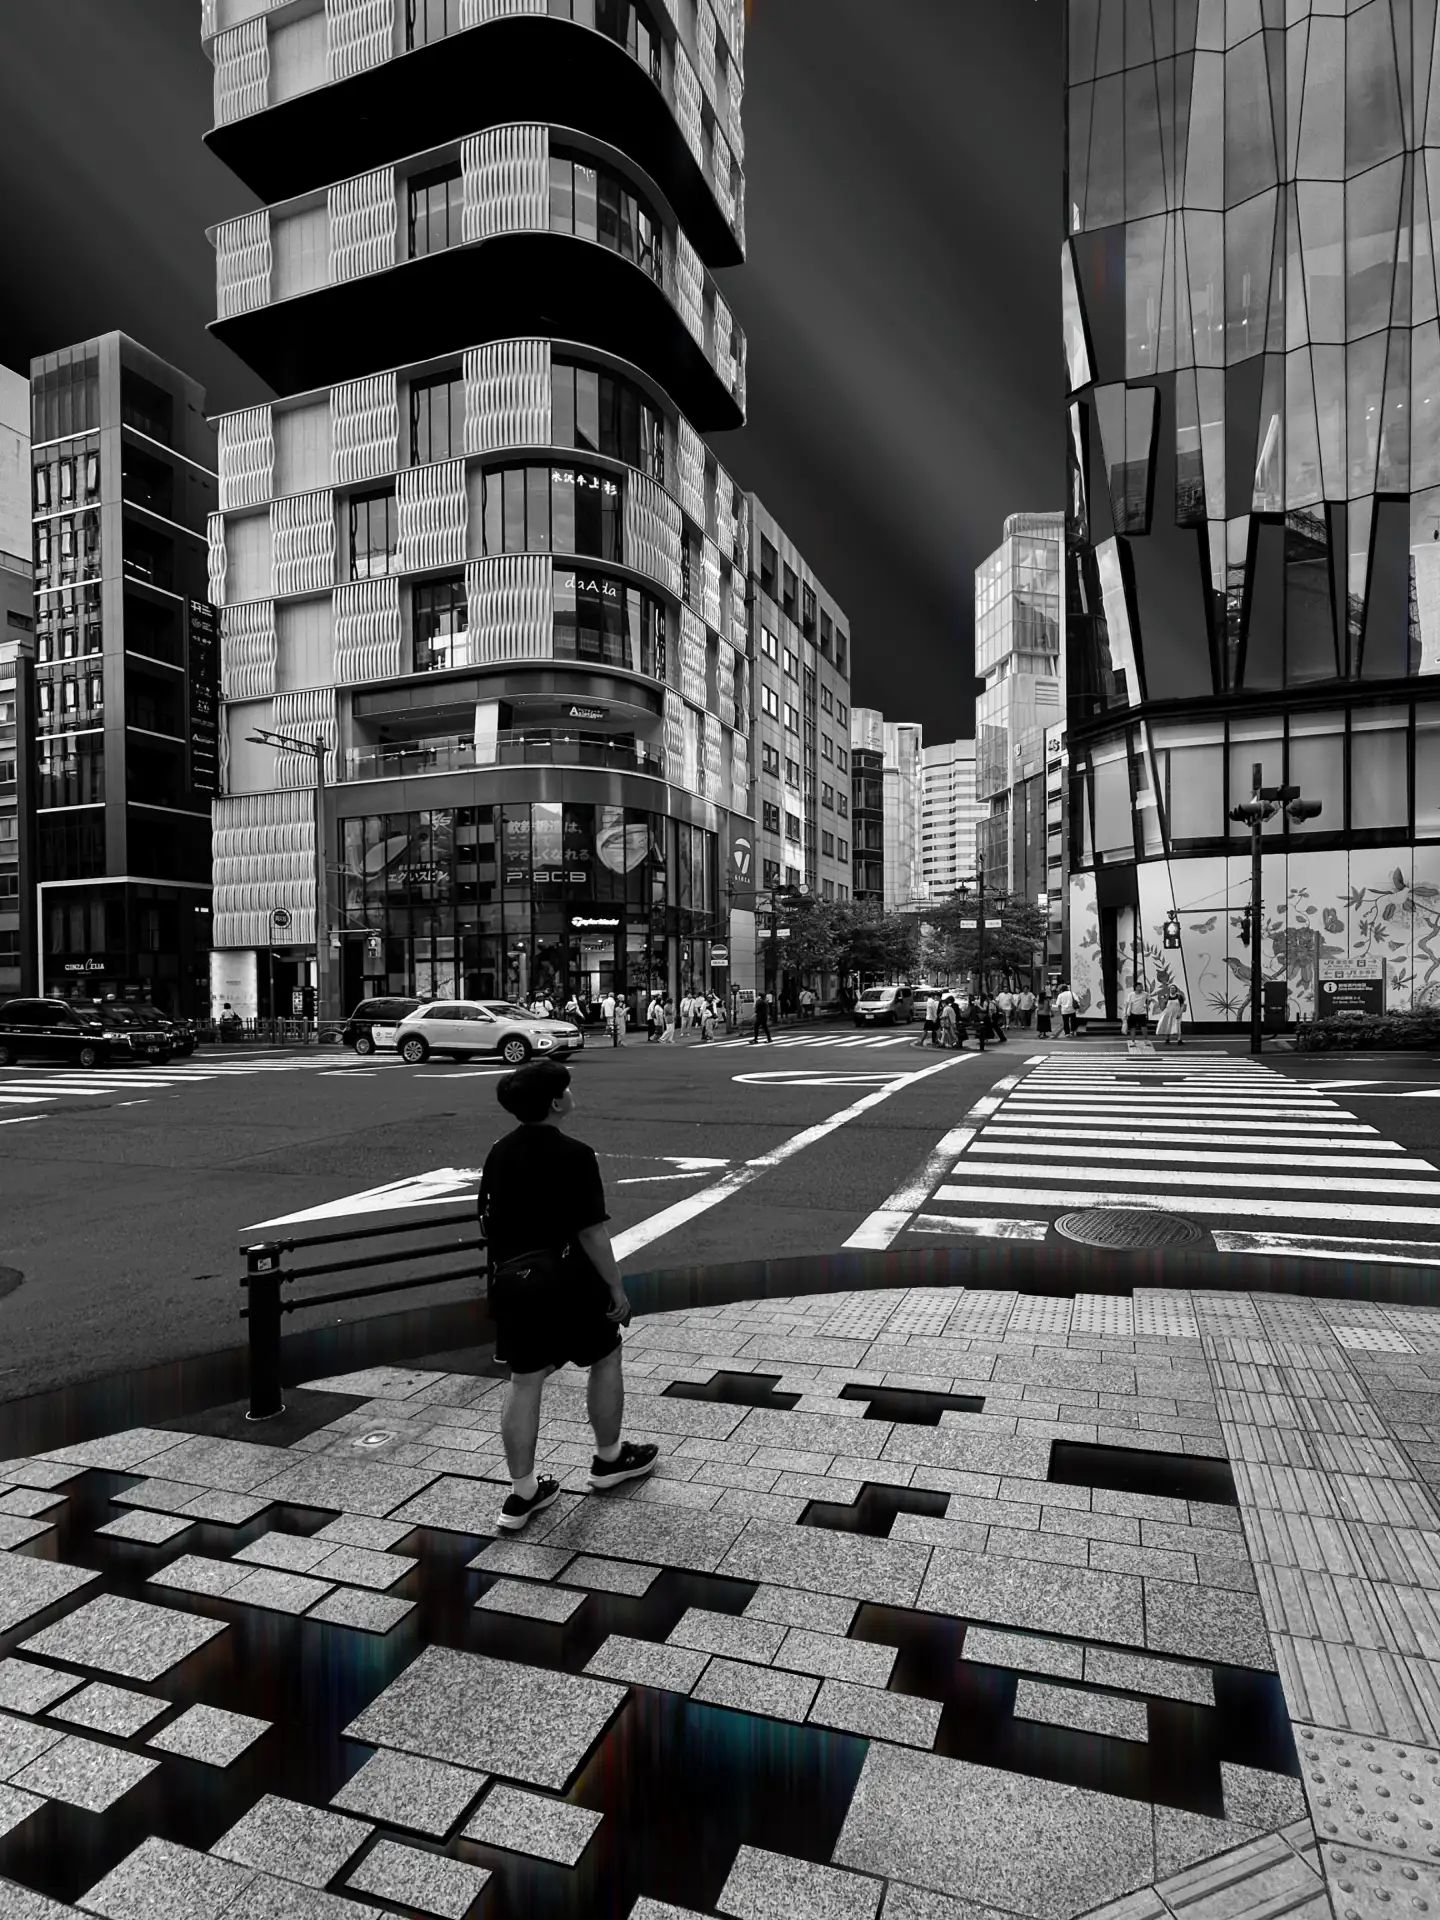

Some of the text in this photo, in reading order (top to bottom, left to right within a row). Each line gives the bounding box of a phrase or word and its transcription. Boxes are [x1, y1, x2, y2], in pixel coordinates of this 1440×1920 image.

[551, 471, 618, 496] 米沢牛上杉
[565, 575, 617, 597] daAda
